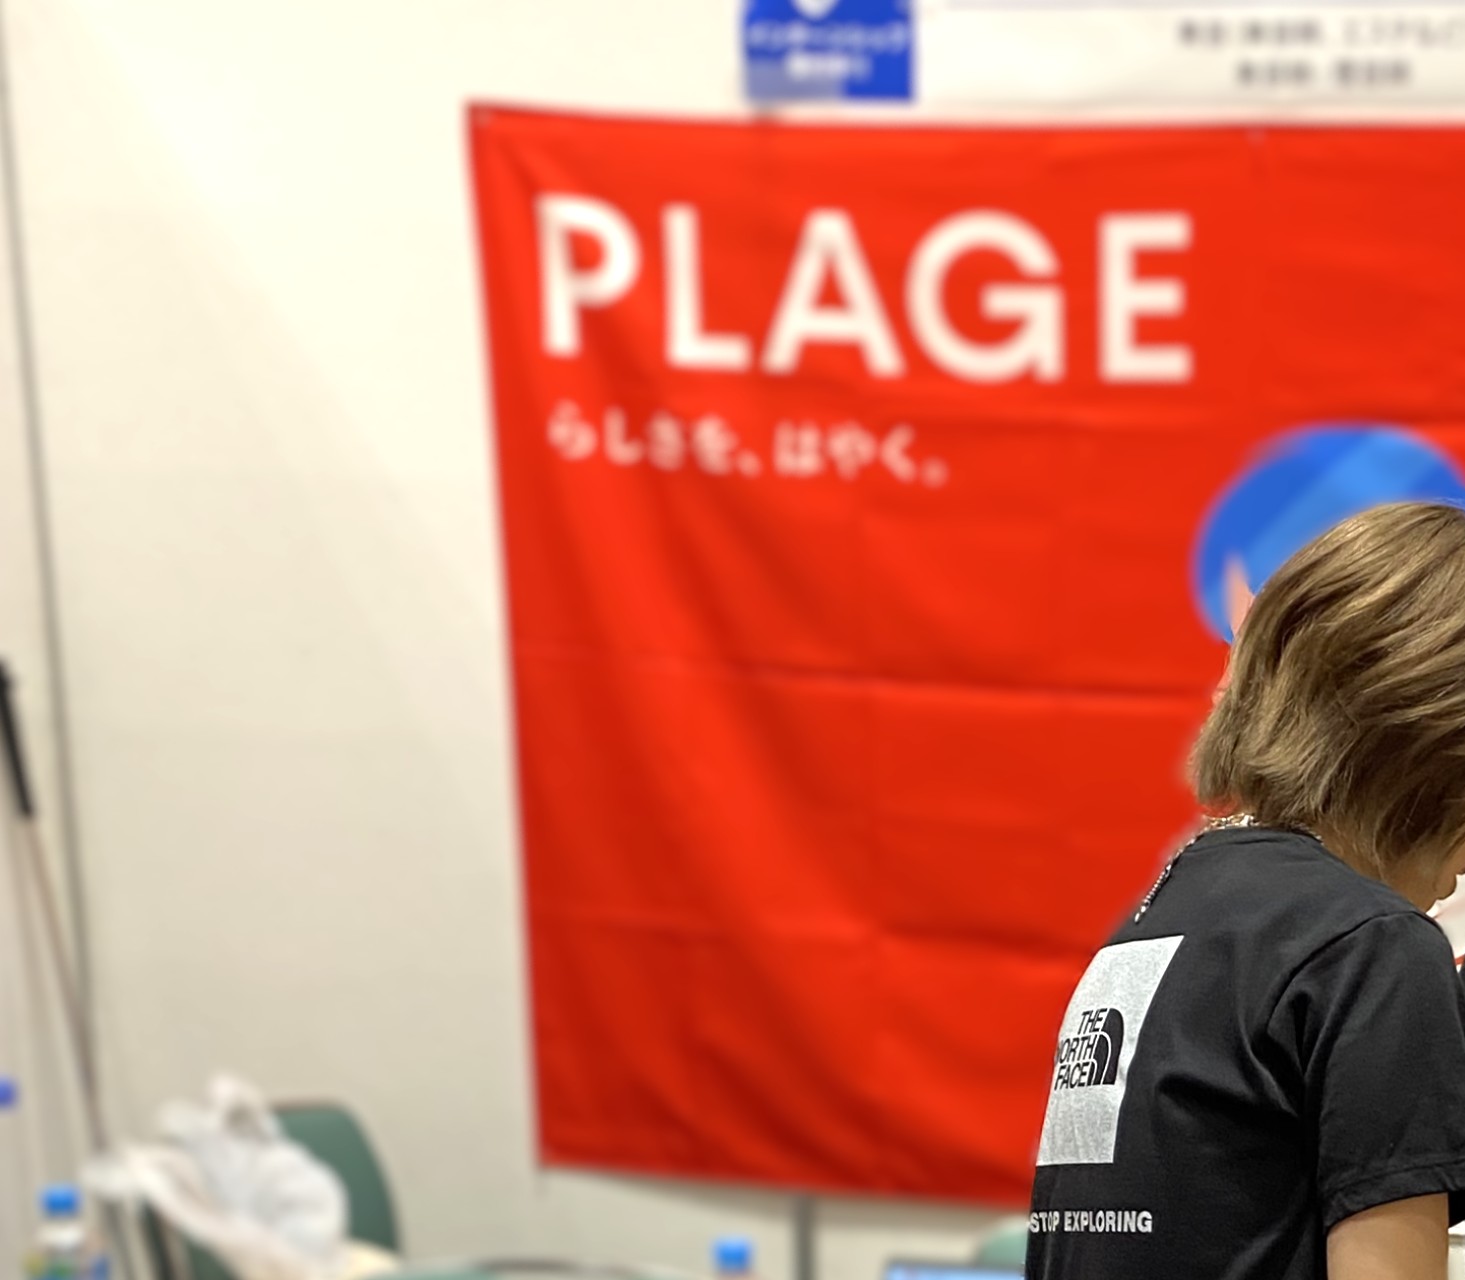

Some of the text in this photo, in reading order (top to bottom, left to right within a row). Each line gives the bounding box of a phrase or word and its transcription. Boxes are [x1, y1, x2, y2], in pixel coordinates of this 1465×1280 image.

[535, 193, 1195, 384] PLAGE
[1078, 1007, 1108, 1035] THE
[1054, 1061, 1090, 1091] FACE
[1029, 1210, 1153, 1233] STOP EXPLORING
